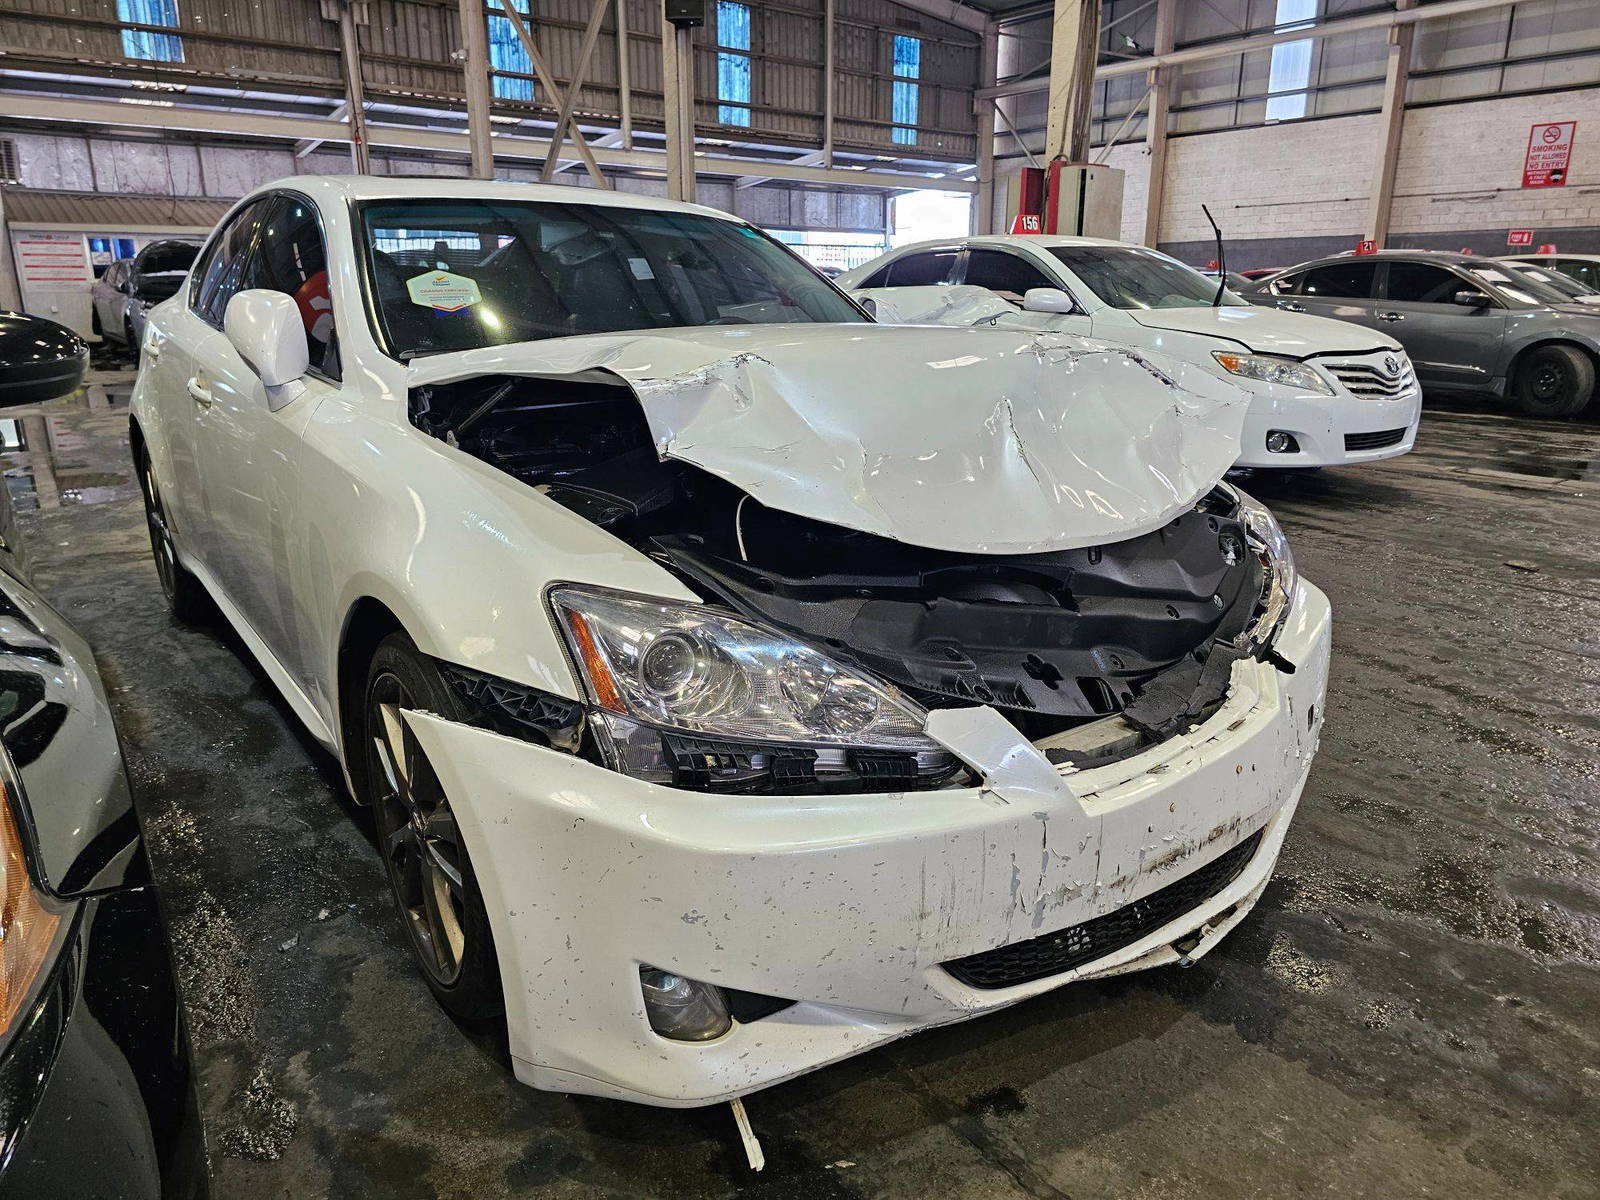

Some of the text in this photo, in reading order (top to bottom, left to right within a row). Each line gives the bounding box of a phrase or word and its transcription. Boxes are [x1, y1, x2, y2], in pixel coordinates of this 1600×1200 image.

[1532, 144, 1567, 152] SMOKING
[1541, 161, 1565, 169] ENTRY
[1022, 216, 1038, 230] 156
[1364, 242, 1373, 251] 21
